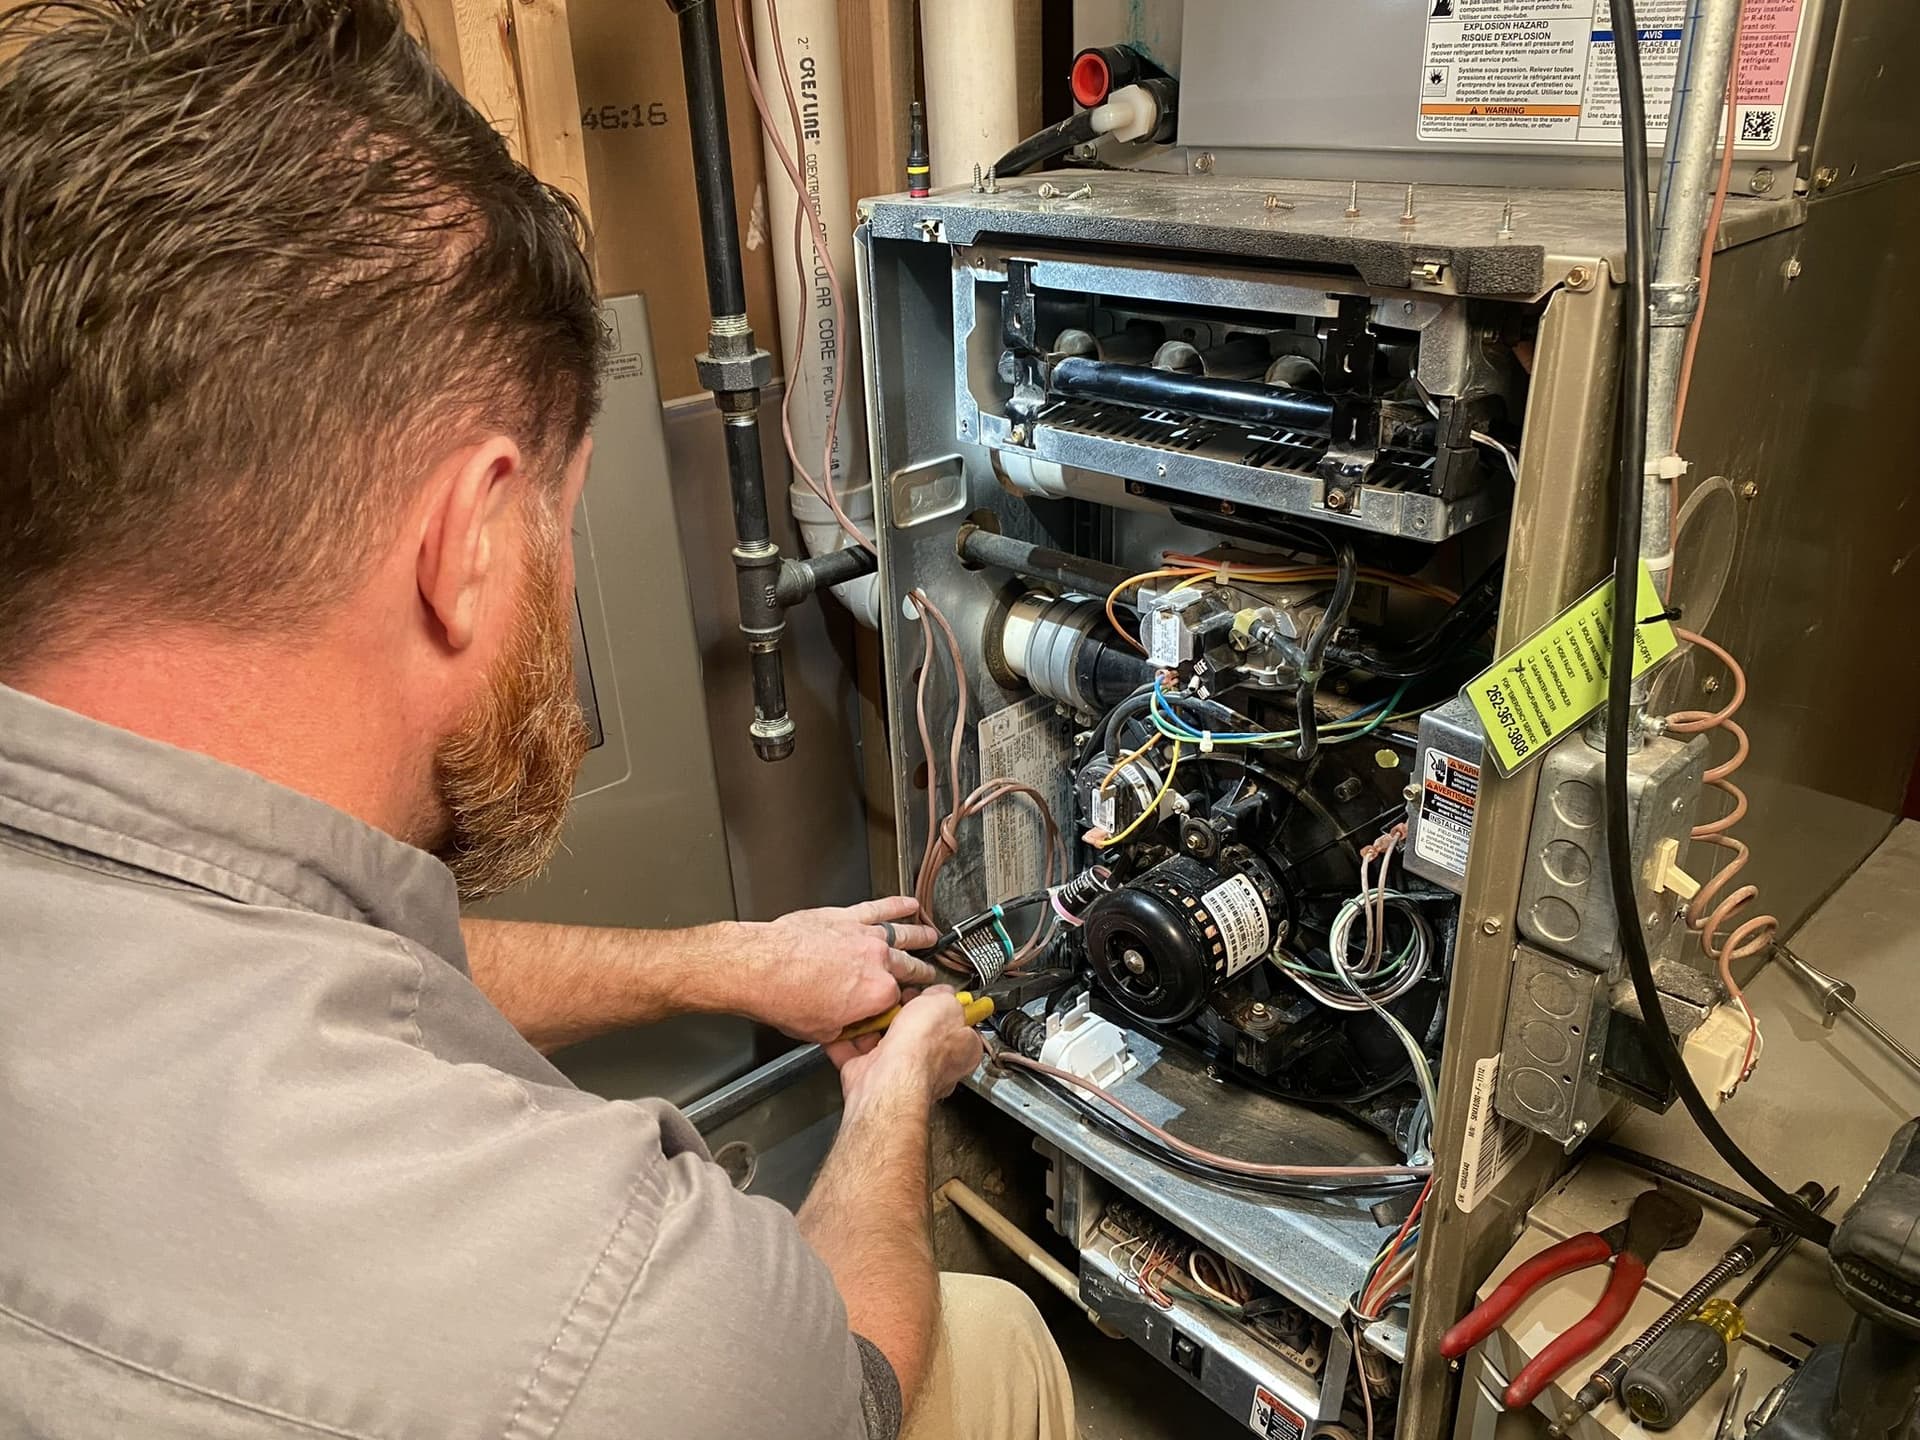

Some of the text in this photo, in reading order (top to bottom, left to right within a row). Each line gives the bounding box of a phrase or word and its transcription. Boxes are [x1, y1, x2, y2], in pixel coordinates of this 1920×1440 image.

[1512, 21, 1549, 29] HAZARD
[1494, 32, 1551, 40] D'EXPLOSION
[1643, 31, 1663, 39] AVIS
[799, 56, 820, 140] CRESLINE
[817, 318, 836, 361] CORE
[822, 366, 833, 385] PVC
[1193, 658, 1208, 676] OFF
[1197, 685, 1210, 700] ON
[1486, 684, 1529, 757] 262-367-3808
